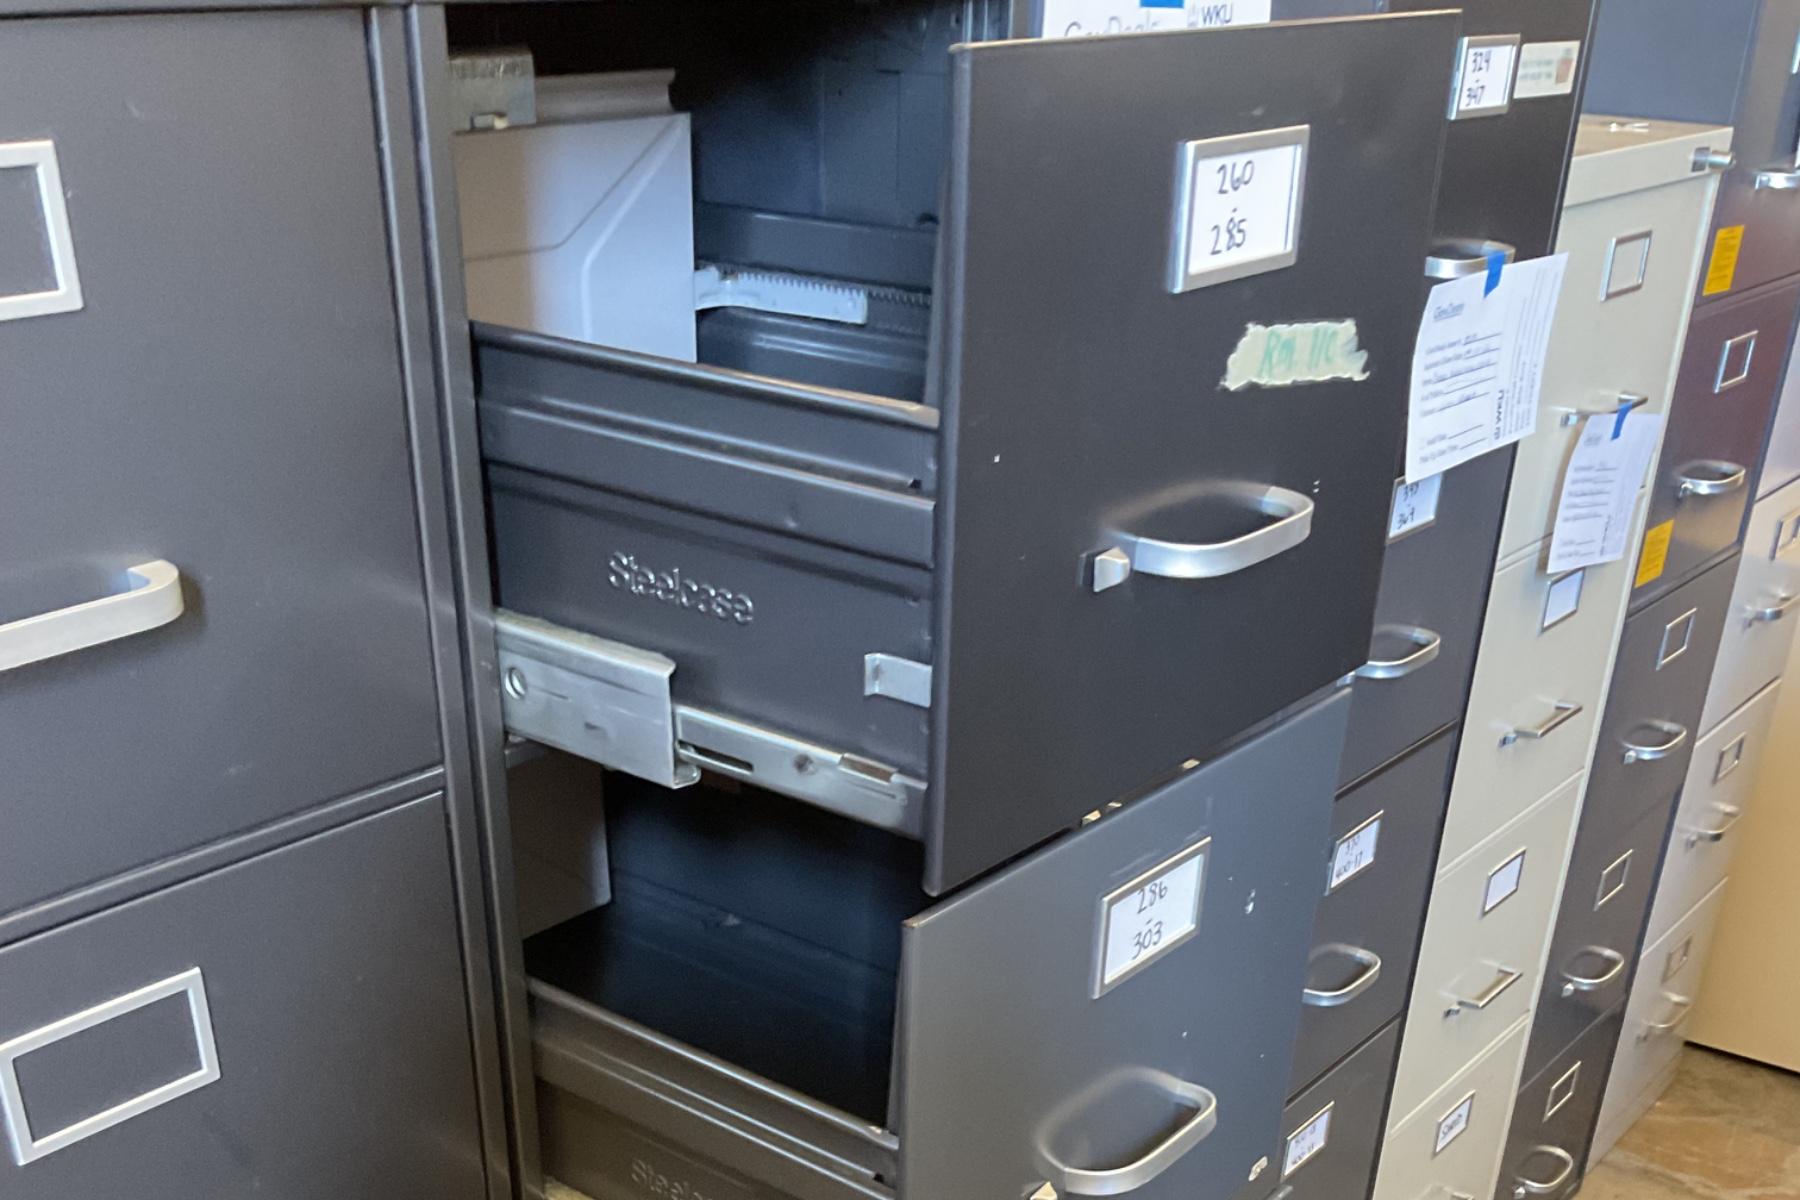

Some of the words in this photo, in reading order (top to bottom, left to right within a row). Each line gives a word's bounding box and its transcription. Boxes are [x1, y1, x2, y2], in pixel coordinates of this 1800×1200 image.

[1216, 160, 1254, 195] 260
[1210, 216, 1247, 256] 285
[608, 551, 753, 625] Steelcase
[1137, 880, 1169, 914] 286
[1132, 920, 1164, 960] 303
